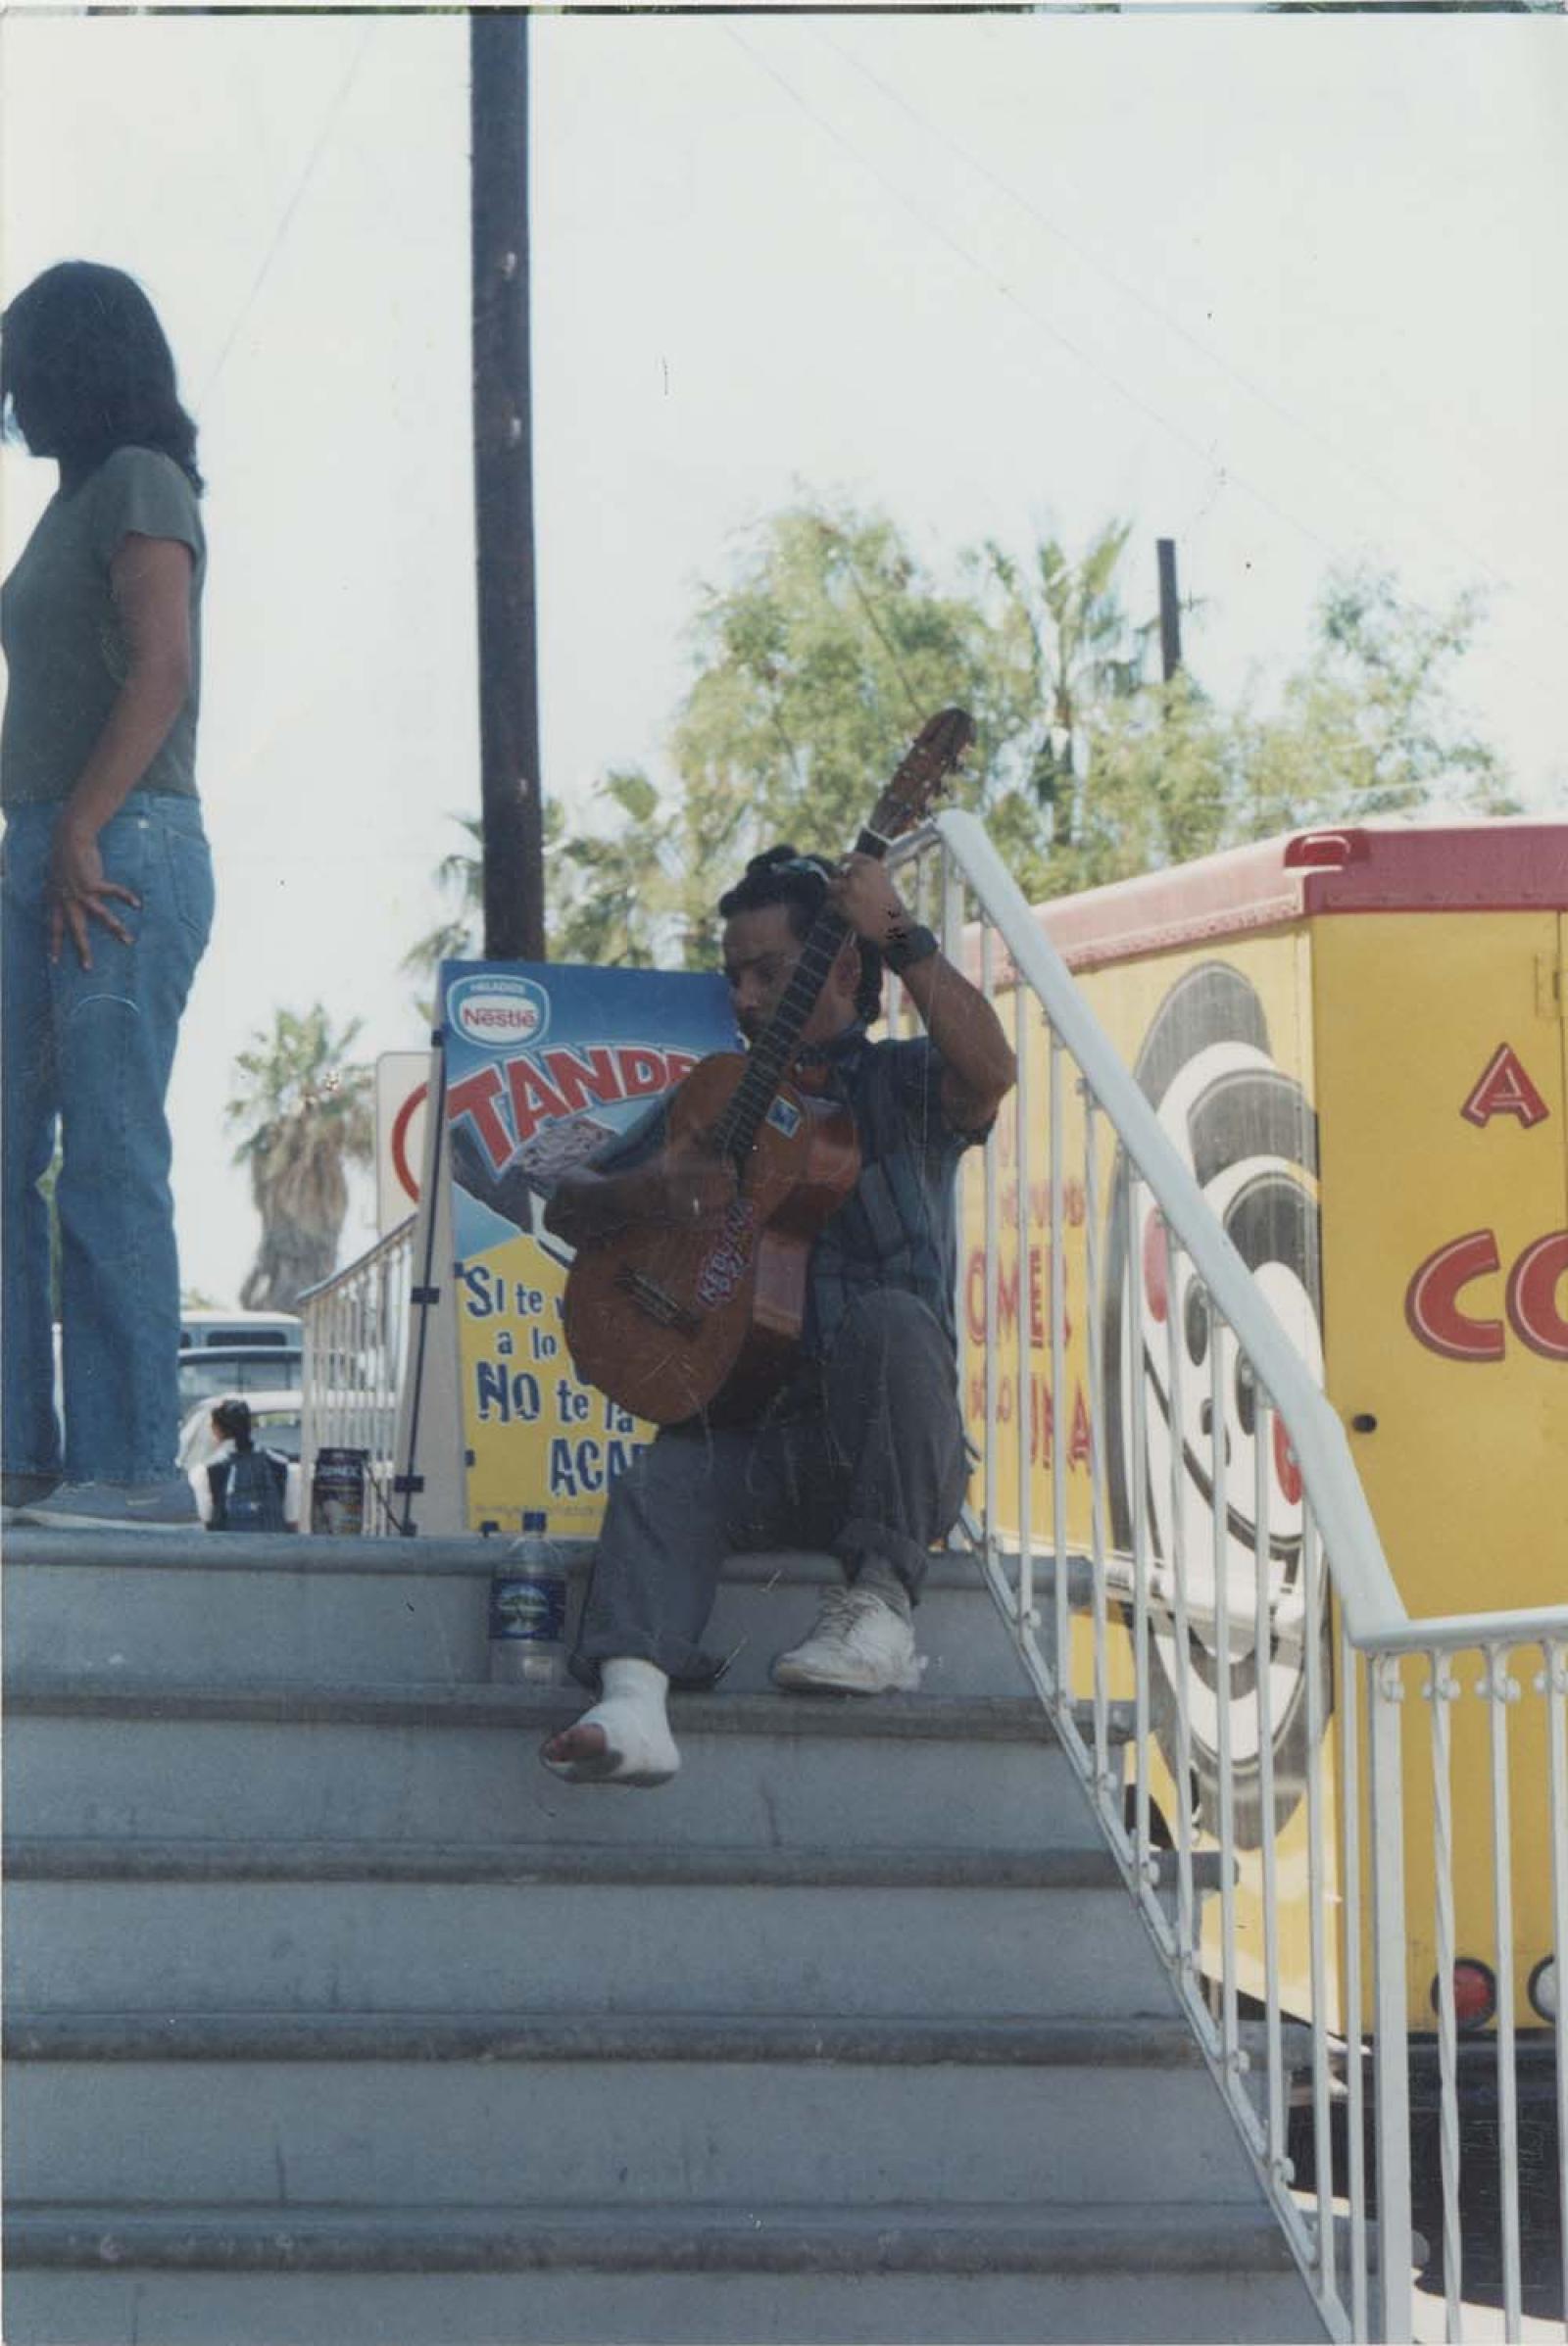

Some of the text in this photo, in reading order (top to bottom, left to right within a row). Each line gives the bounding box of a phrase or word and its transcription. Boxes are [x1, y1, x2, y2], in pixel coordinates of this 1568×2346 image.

[1460, 1041, 1550, 1129] A
[466, 1265, 504, 1318] SI
[515, 1283, 543, 1316] te
[497, 1327, 558, 1360] a lo
[476, 1361, 540, 1422] NO
[557, 1379, 589, 1422] te
[551, 1438, 645, 1496] ACA
